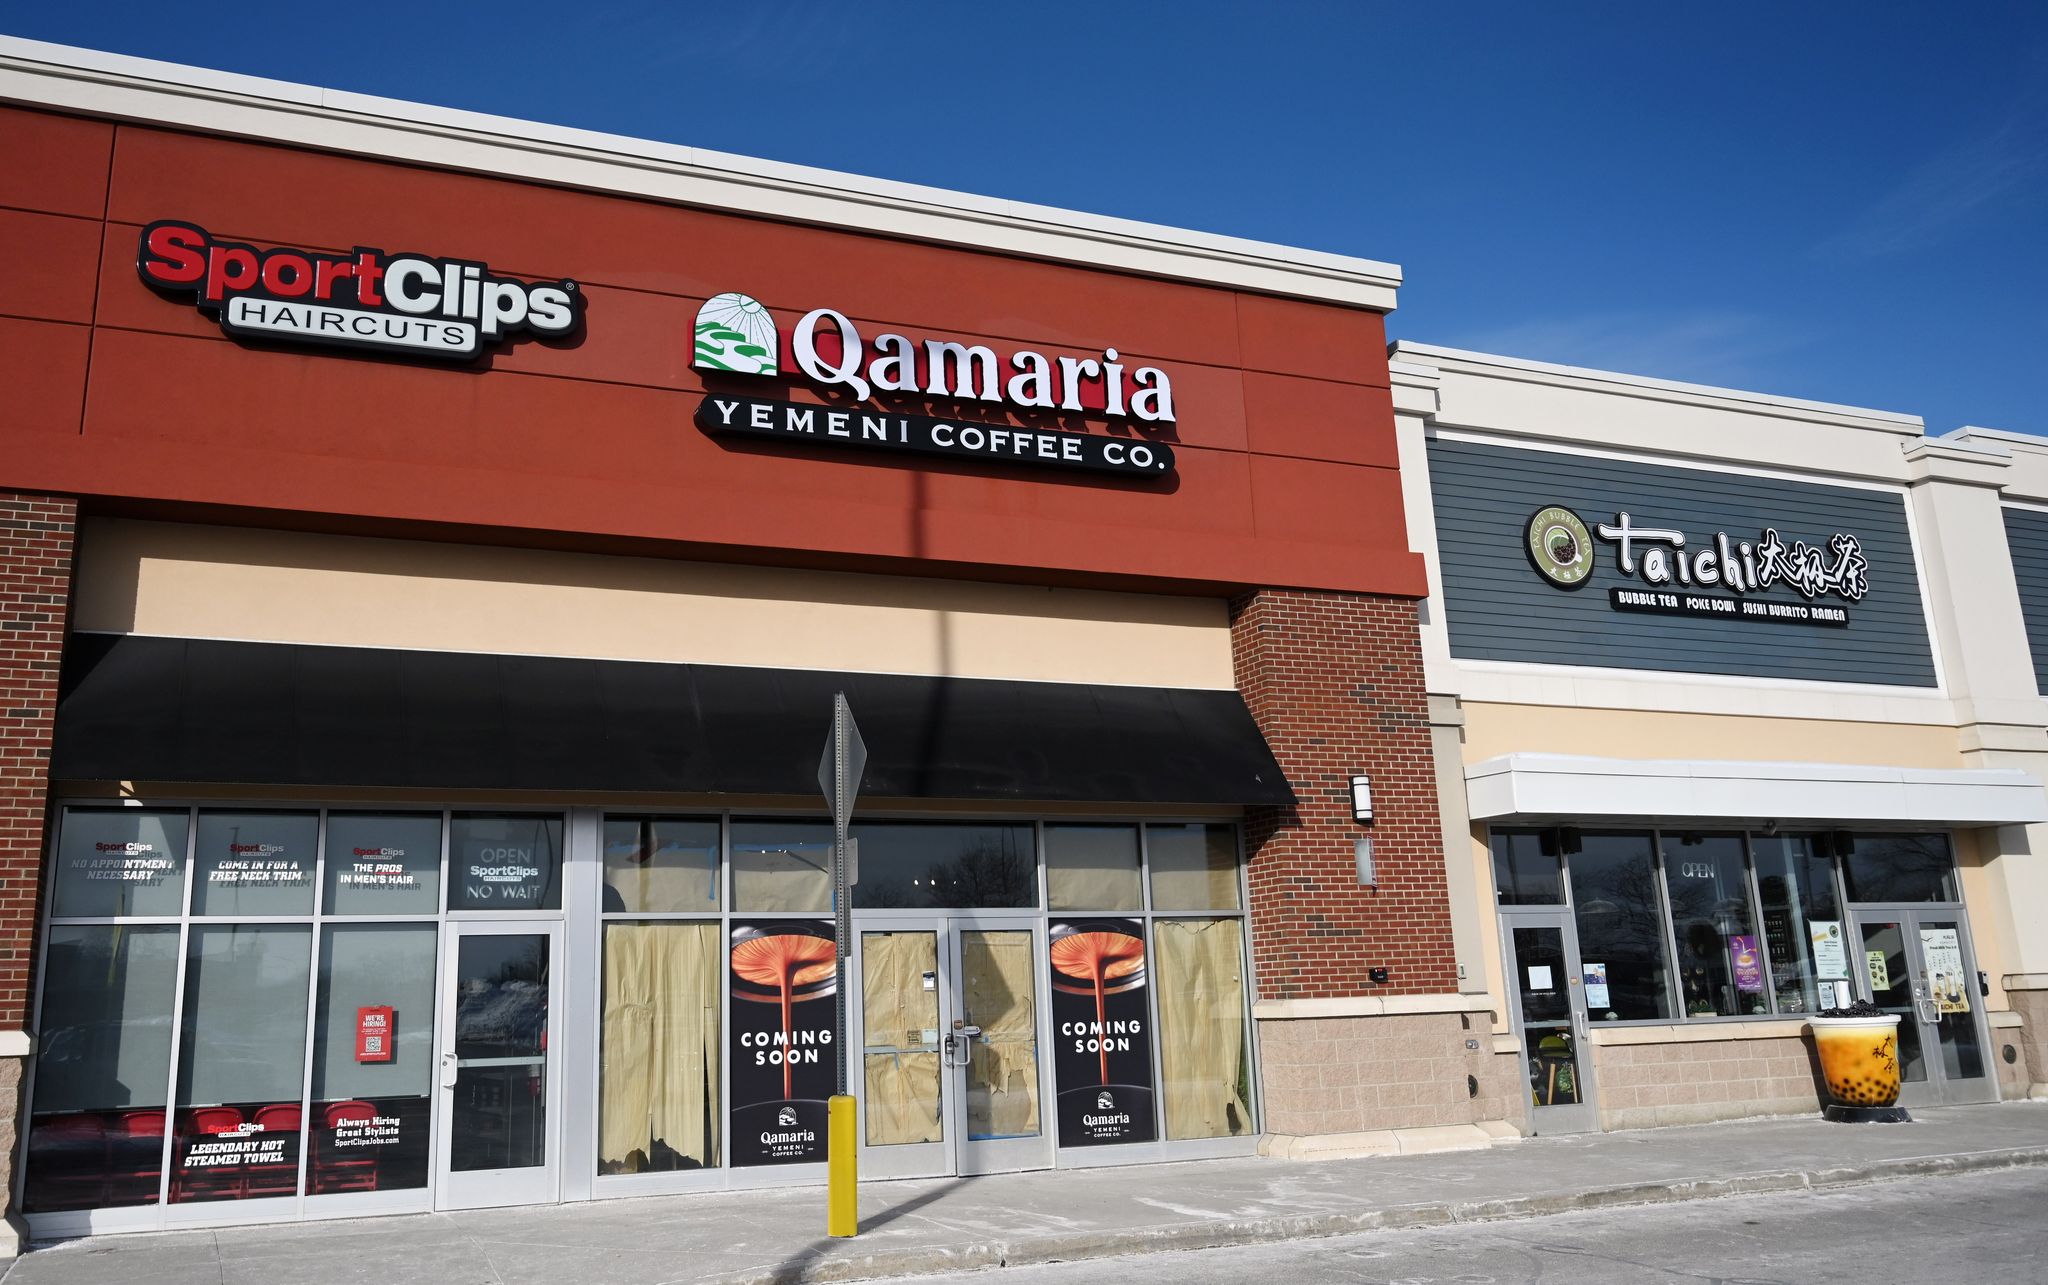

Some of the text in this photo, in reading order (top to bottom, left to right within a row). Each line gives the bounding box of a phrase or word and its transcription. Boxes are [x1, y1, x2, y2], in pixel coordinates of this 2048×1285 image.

[145, 226, 572, 334] SportClips
[240, 301, 465, 346] HAIRCUTS
[792, 308, 1177, 423] Qamaria
[714, 399, 1166, 470] YEMENI COFFEE CO.
[1548, 511, 1580, 530] BUBBLE
[1582, 536, 1591, 555] TEA
[1618, 591, 1846, 621] BUBBLE TEA POKE BOWL SUSHI BURRITO RAMEN
[96, 842, 153, 852] SportClips
[480, 848, 531, 864] OPEN
[72, 859, 174, 869] NO APPOINTMENT
[218, 860, 299, 870] COME IN FOR A
[353, 863, 403, 873] THE PROS
[470, 865, 539, 878] SportClips
[1682, 862, 1714, 878] OPEN
[86, 870, 154, 880] NECESSARY
[209, 871, 303, 881] FREE NECK TRIM
[340, 874, 414, 884] IN MEN'S HAIR
[467, 885, 540, 898] NO WAIT
[1062, 1020, 1141, 1036] COMING
[741, 1029, 832, 1047] COMING
[1075, 1038, 1130, 1053] SOON
[755, 1049, 819, 1066] SOON
[336, 1116, 400, 1128] Always Hiring
[1083, 1112, 1130, 1127] Qamaria
[208, 1122, 264, 1134] SportClips
[336, 1127, 400, 1137] Great Stylists
[335, 1137, 400, 1147] SportClipsJobs.com
[760, 1129, 815, 1145] Qamaria
[190, 1140, 285, 1154] LEGENDARY HOT
[184, 1152, 284, 1167] STEAMED TOWEL
